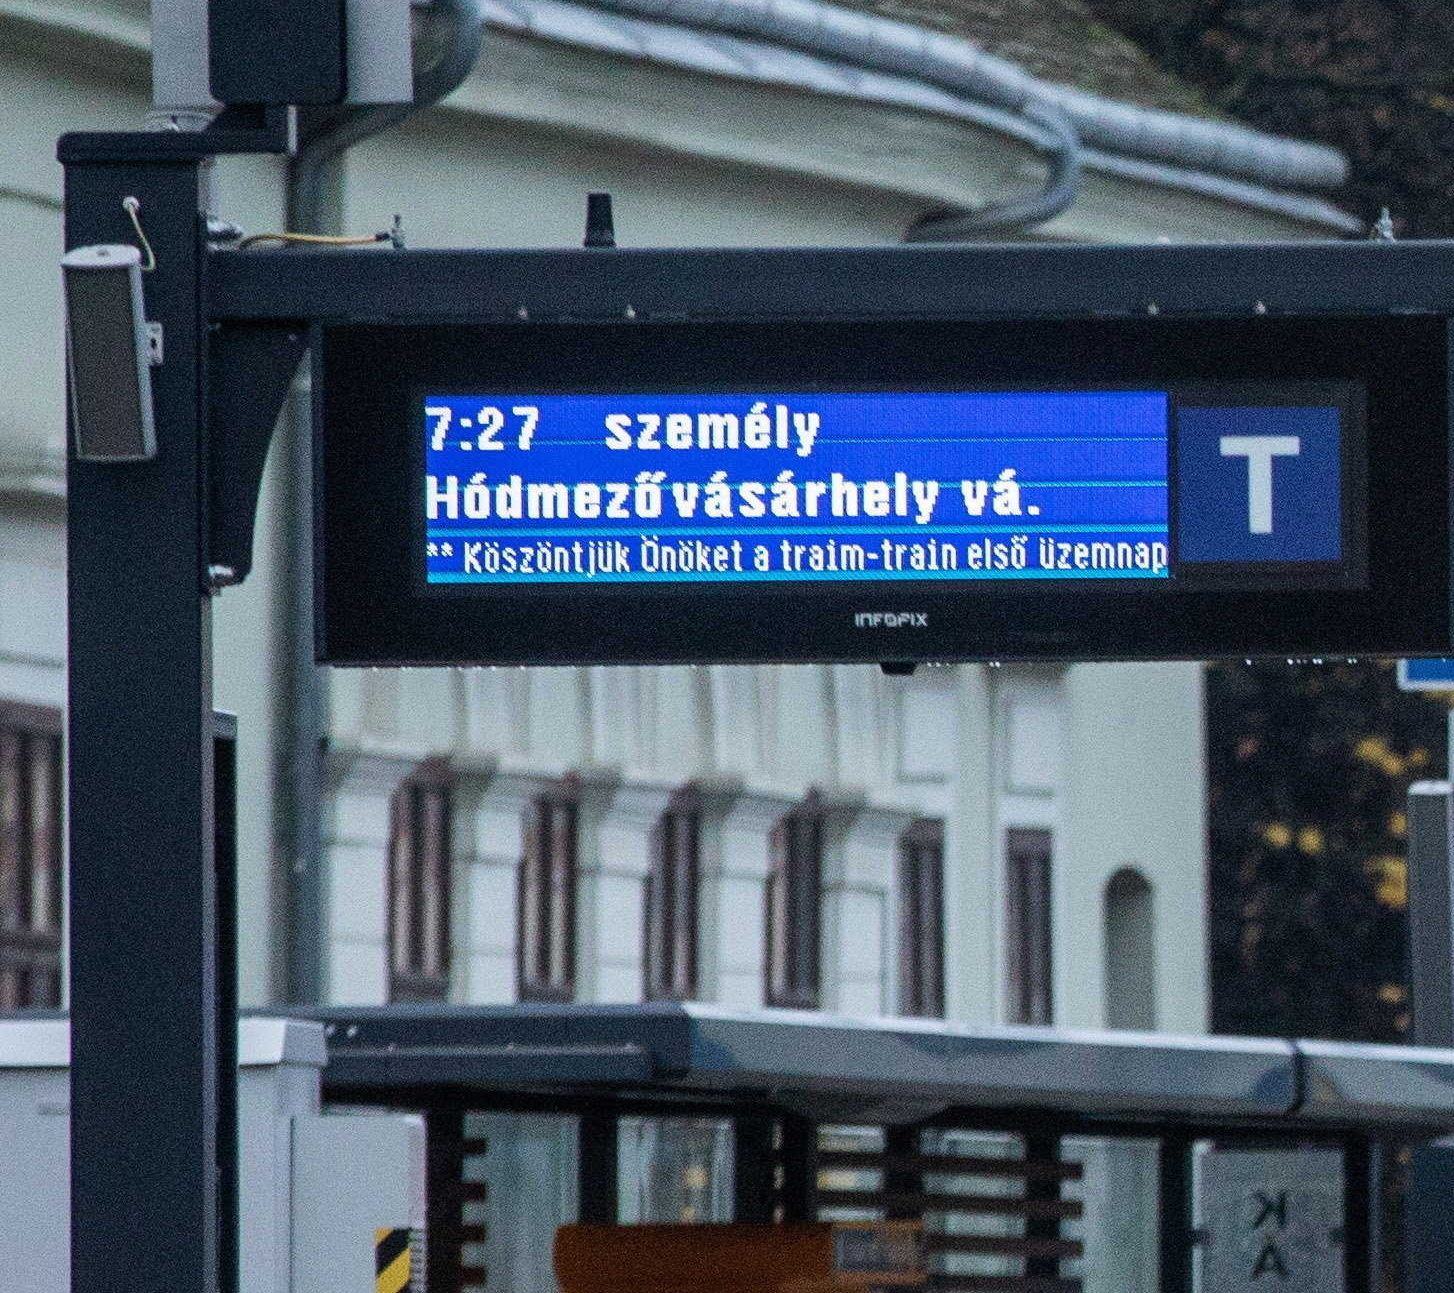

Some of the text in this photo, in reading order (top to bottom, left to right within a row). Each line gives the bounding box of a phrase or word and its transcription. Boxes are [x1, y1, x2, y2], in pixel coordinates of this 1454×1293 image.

[425, 400, 821, 458] 7:27 személy
[425, 467, 1041, 525] Hódmezővásárhely vá.
[1219, 435, 1301, 535] T
[463, 540, 631, 578] Köszöntjük
[640, 533, 743, 574] Önöket
[753, 548, 770, 571] a
[966, 534, 1029, 571] első
[1038, 536, 1168, 575] üzemnap
